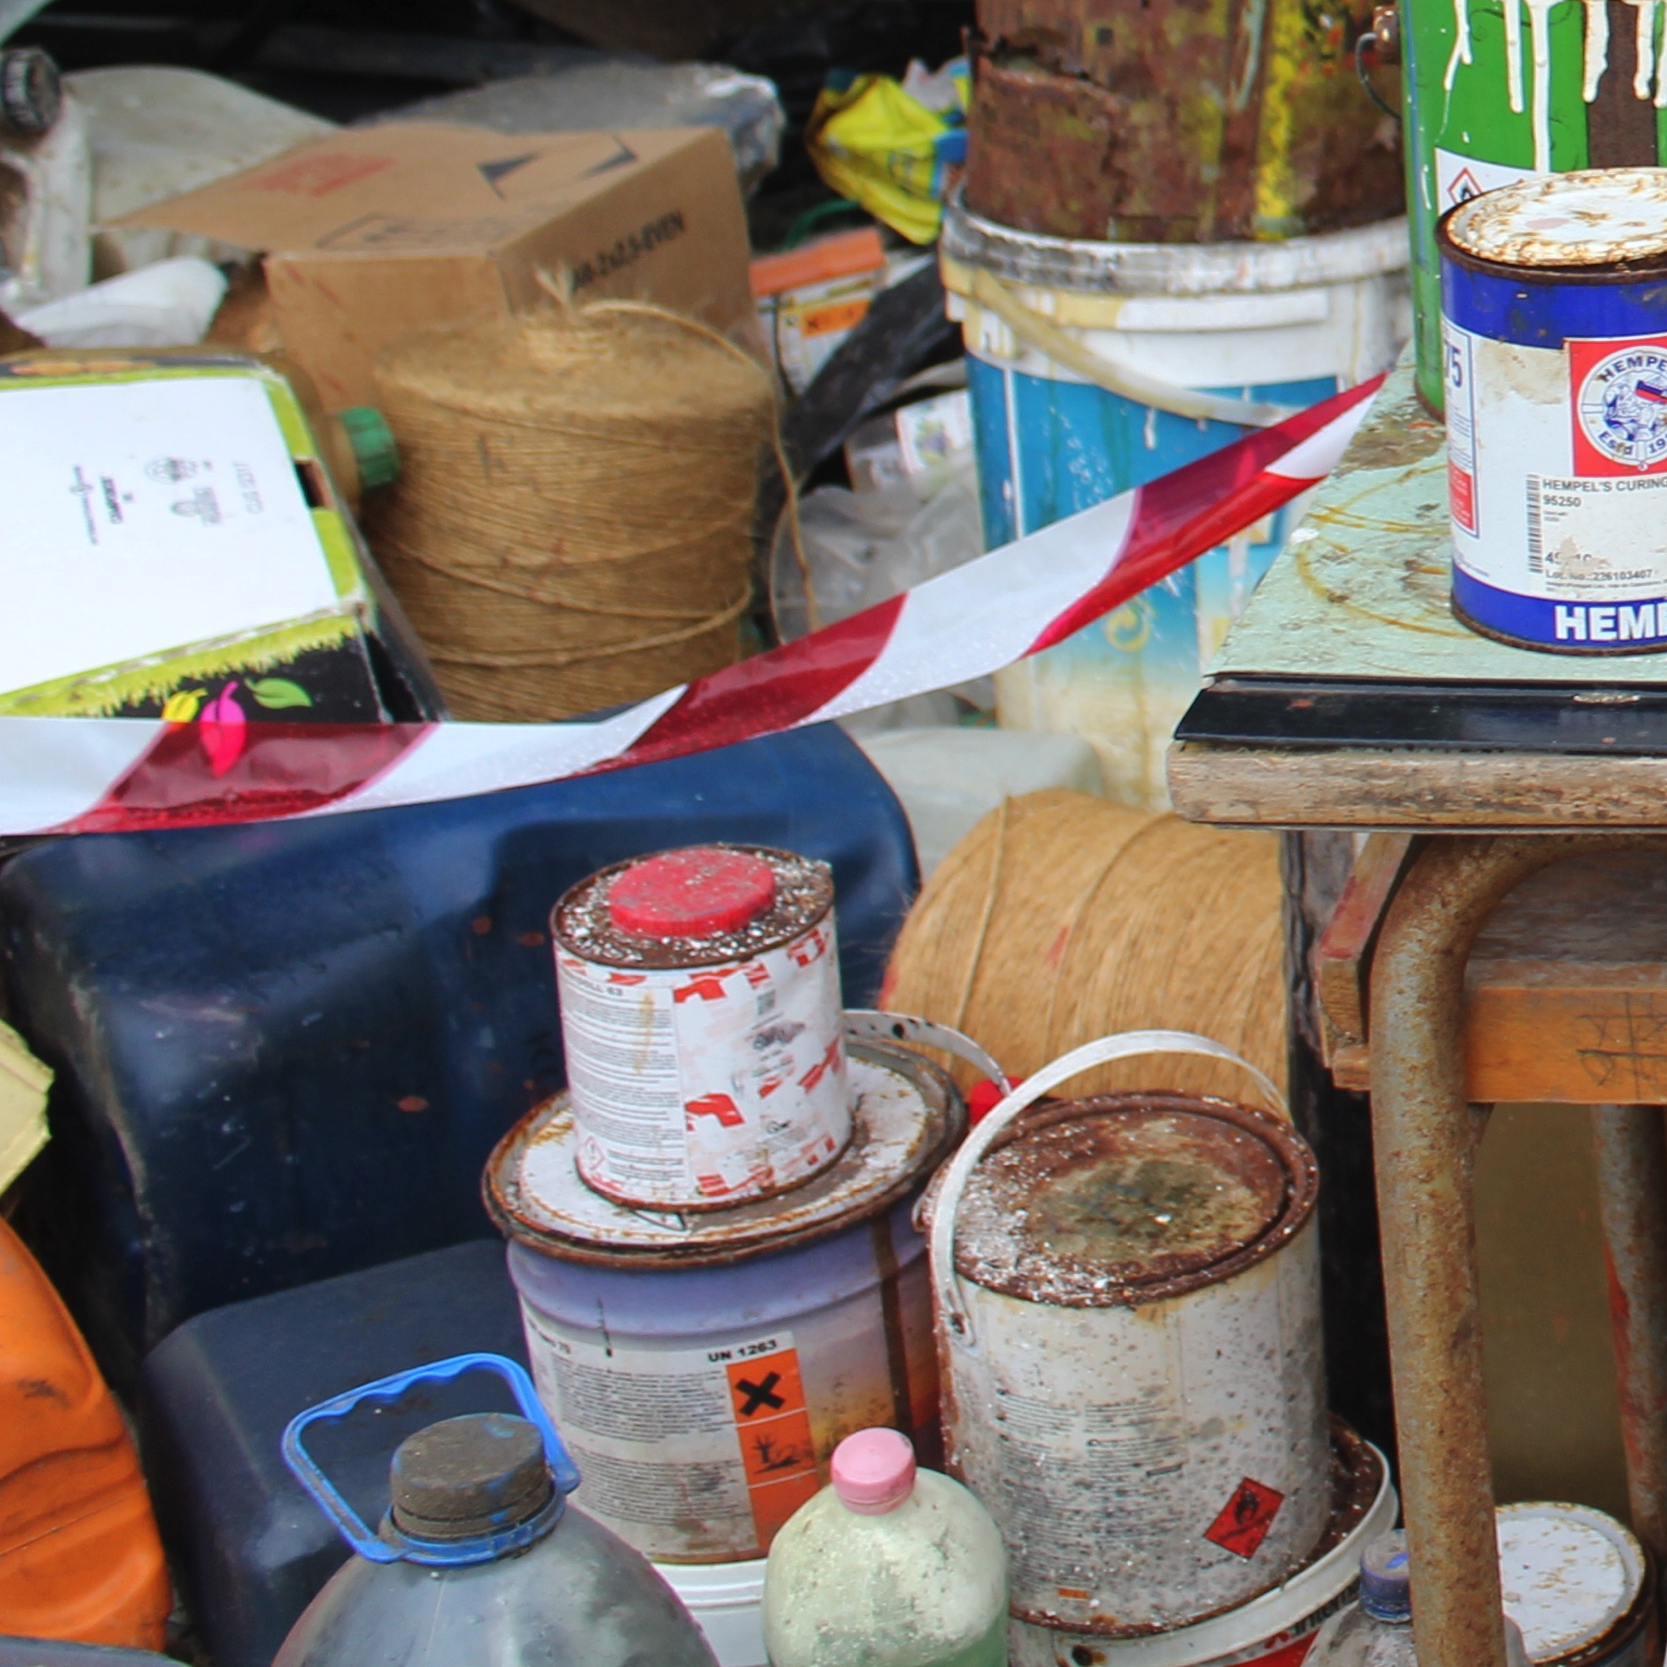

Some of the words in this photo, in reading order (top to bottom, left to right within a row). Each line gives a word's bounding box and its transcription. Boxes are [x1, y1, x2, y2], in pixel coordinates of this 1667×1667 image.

[1542, 479, 1612, 493] HEMPEL'S
[1543, 494, 1582, 508] 95250
[708, 1349, 732, 1363] UN
[737, 1339, 778, 1358] 1263
